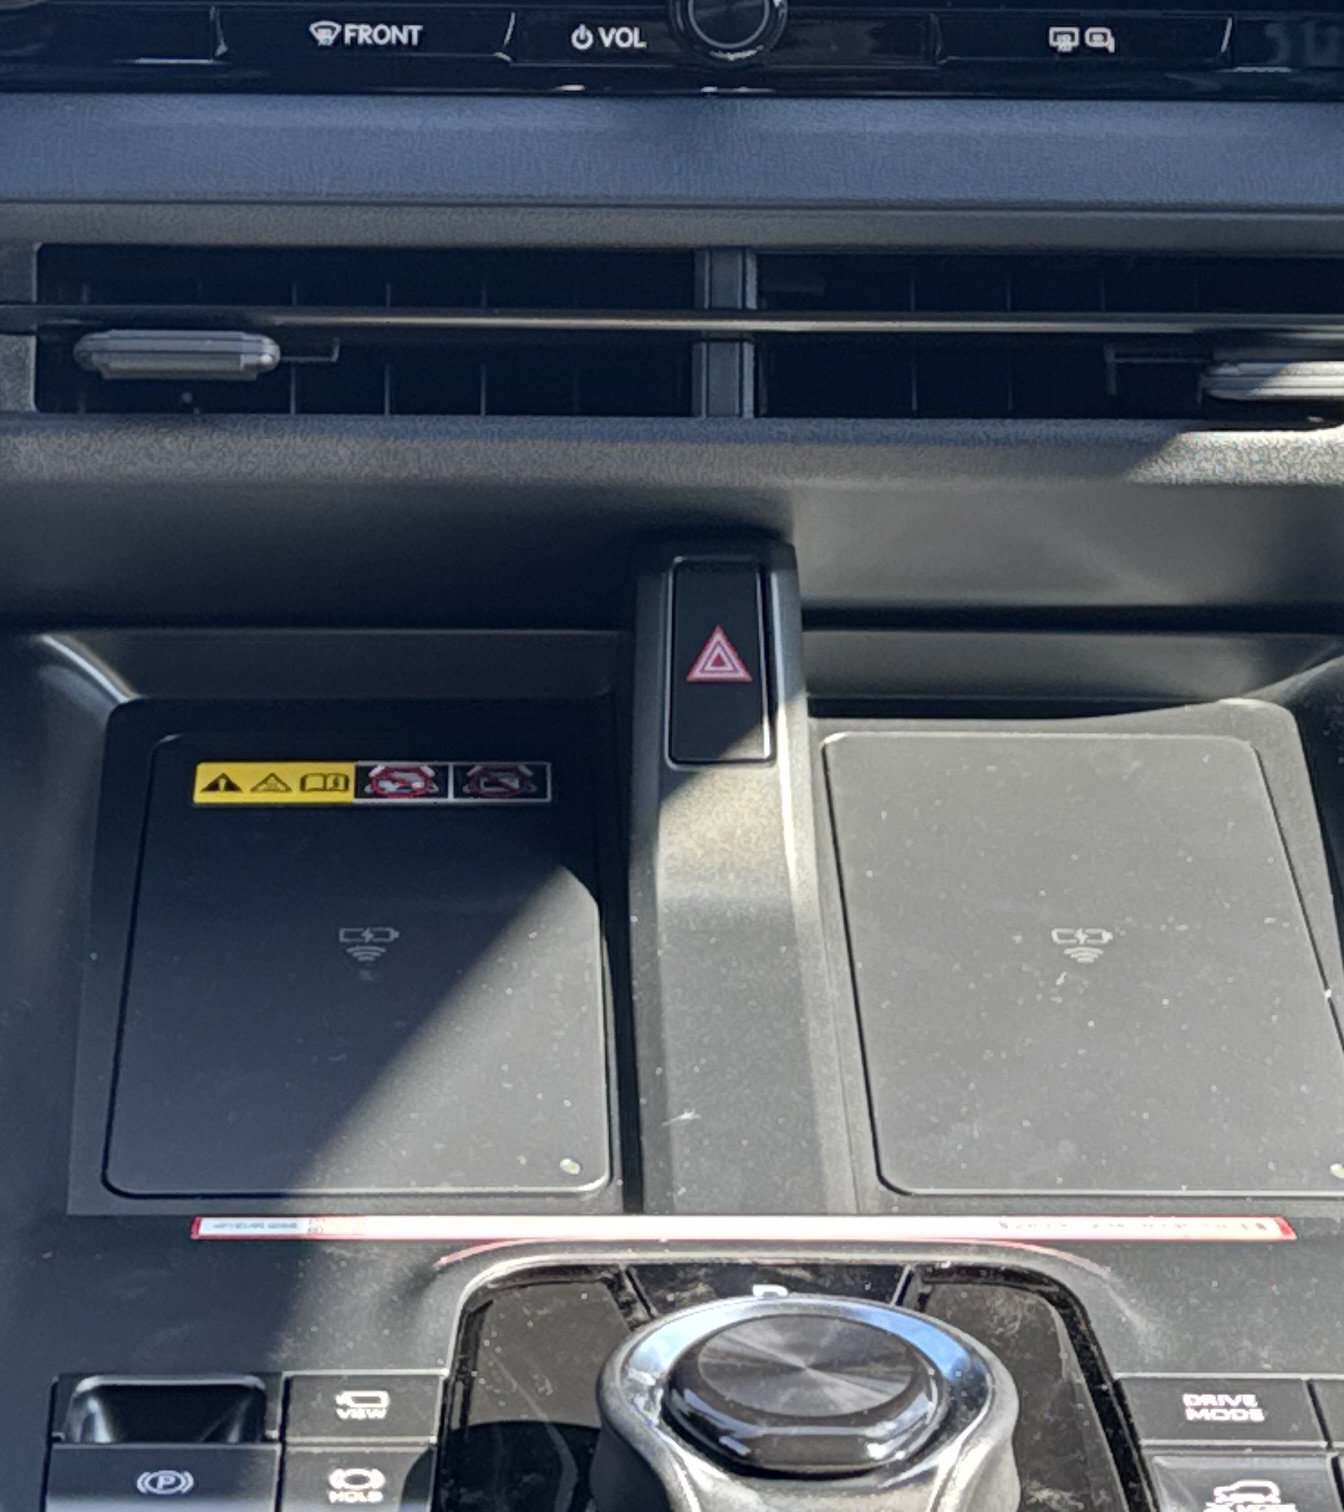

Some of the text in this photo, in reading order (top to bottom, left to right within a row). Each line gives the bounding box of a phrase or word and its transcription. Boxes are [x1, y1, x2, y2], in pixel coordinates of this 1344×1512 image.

[344, 24, 423, 46] FRONT
[598, 26, 647, 48] VOL
[1182, 1392, 1258, 1408] DRIVE
[336, 1407, 387, 1420] VIEW
[1185, 1407, 1265, 1422] MODE
[329, 1491, 384, 1504] HOLD
